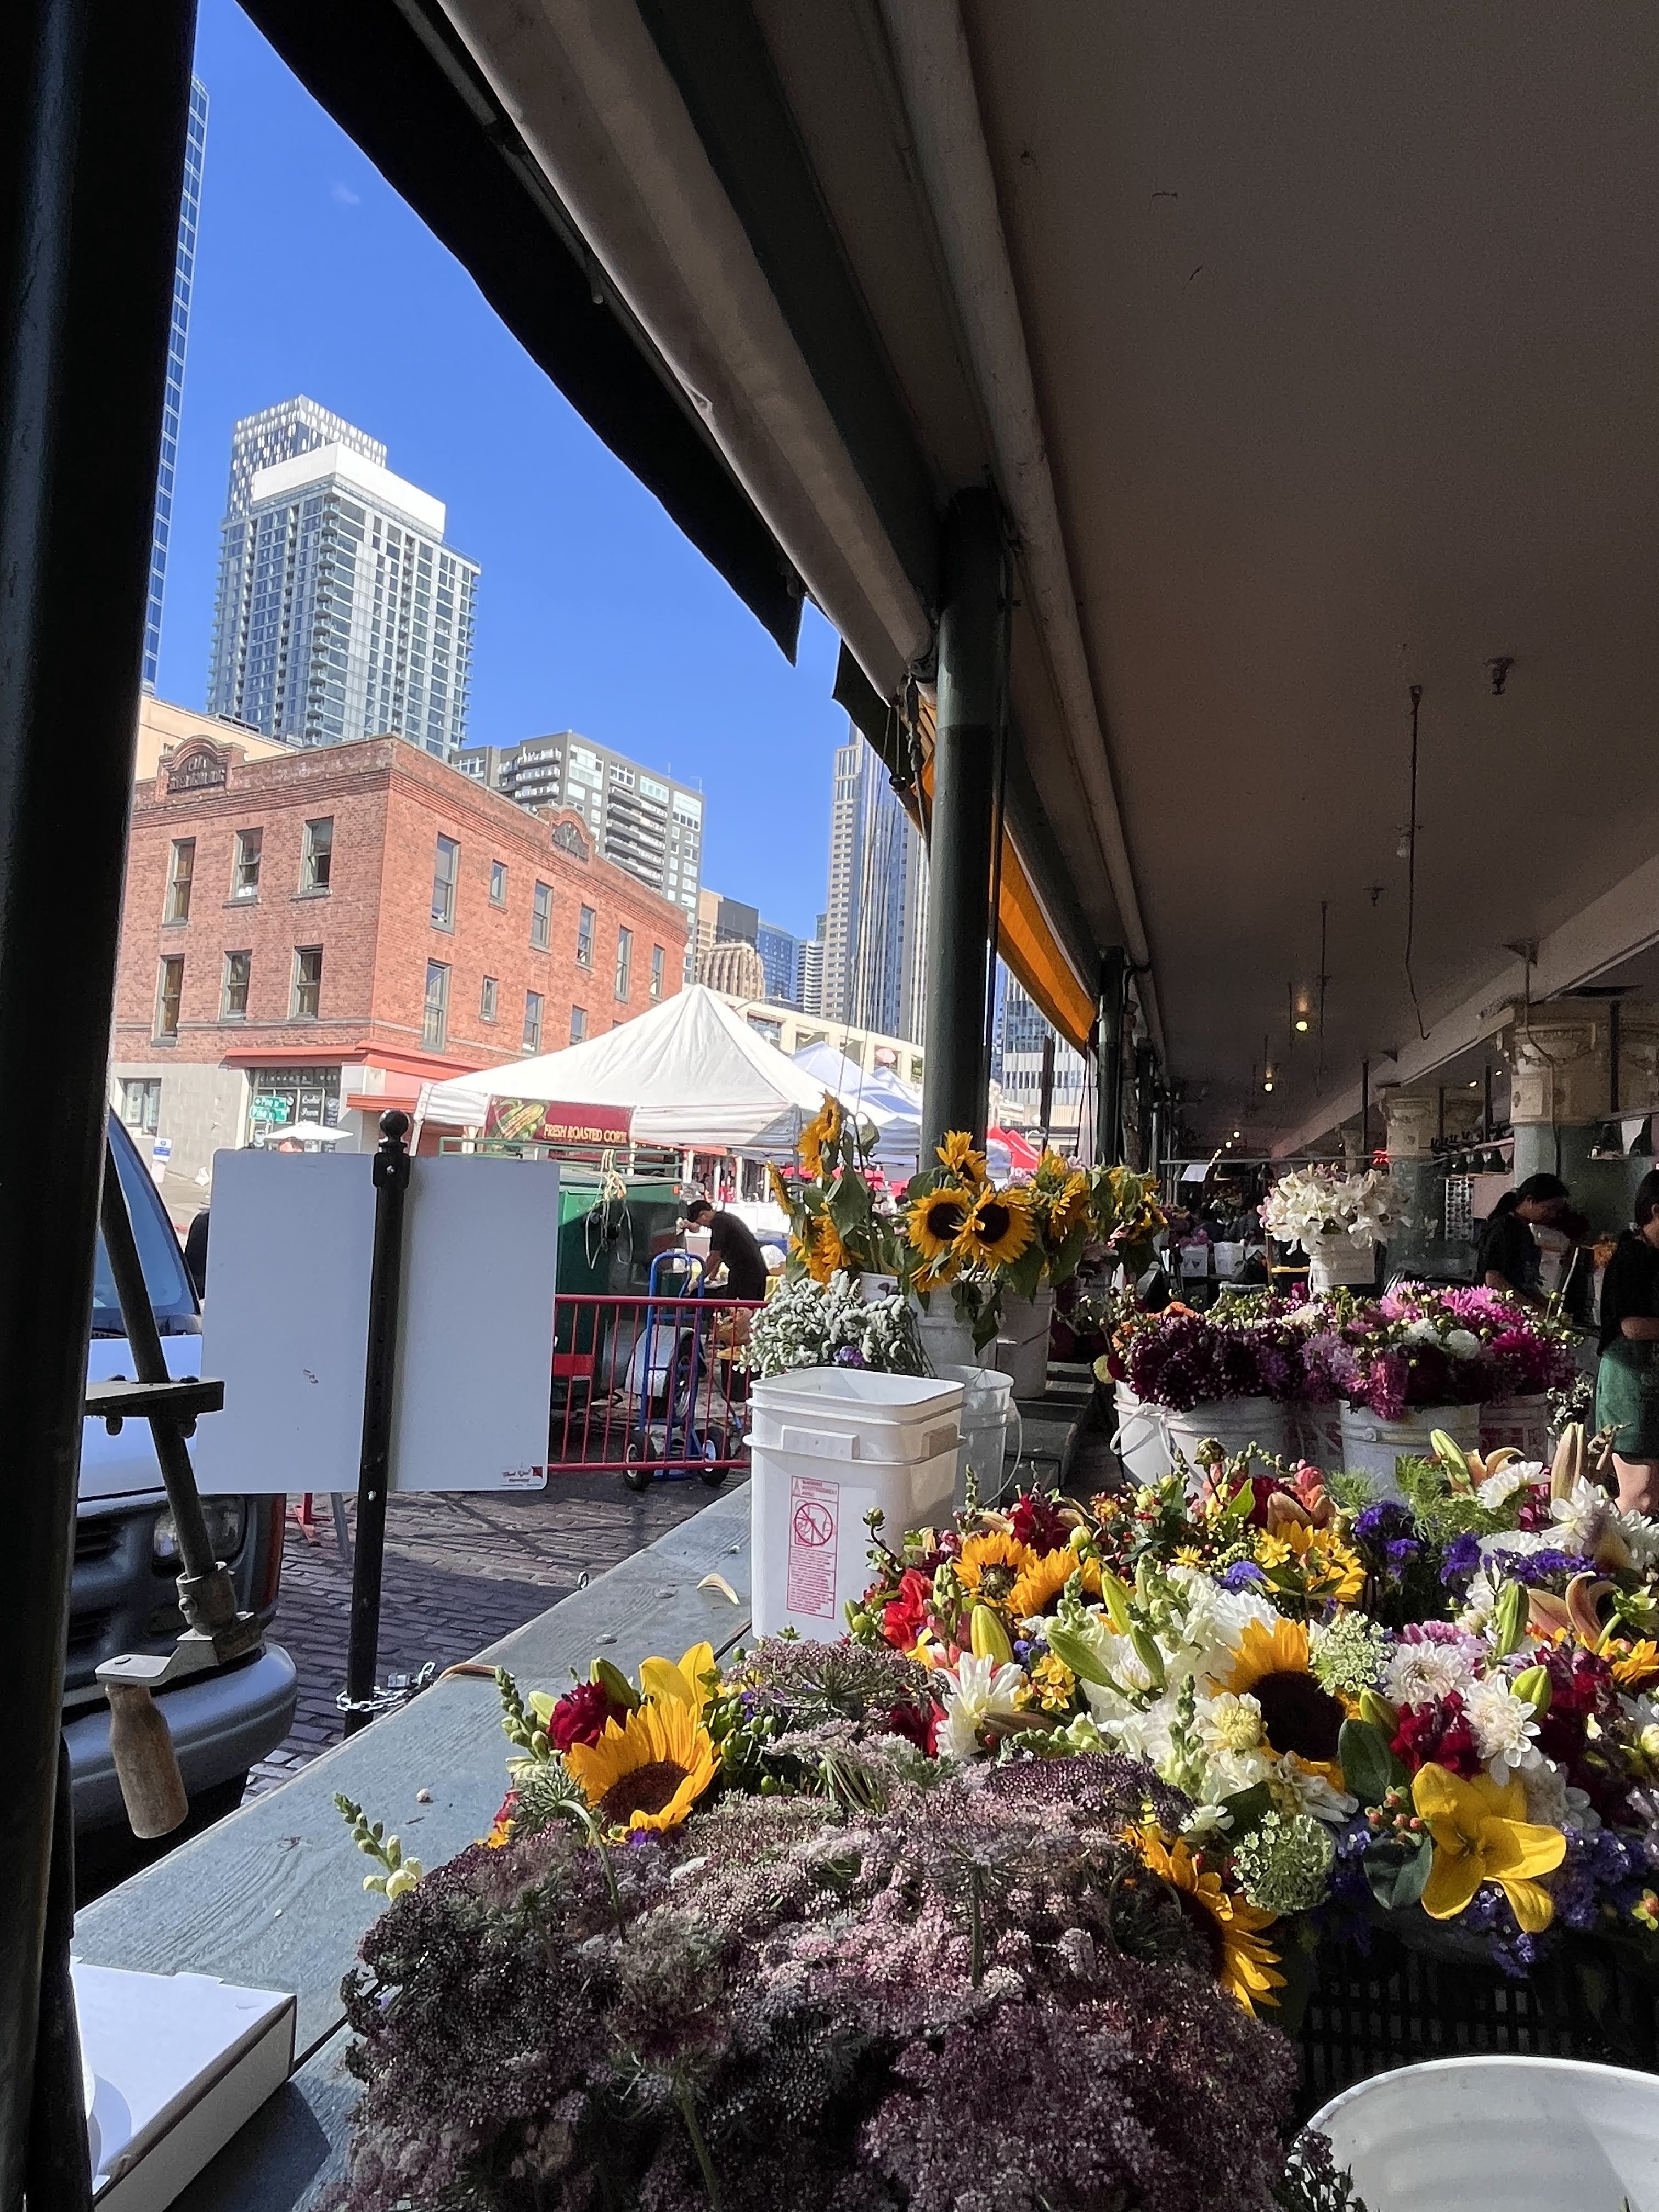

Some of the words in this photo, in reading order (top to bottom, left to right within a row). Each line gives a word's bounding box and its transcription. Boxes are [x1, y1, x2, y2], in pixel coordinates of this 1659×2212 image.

[544, 1124, 567, 1138] FRESH
[567, 1126, 602, 1141] ROASTED
[603, 1129, 627, 1143] CORN
